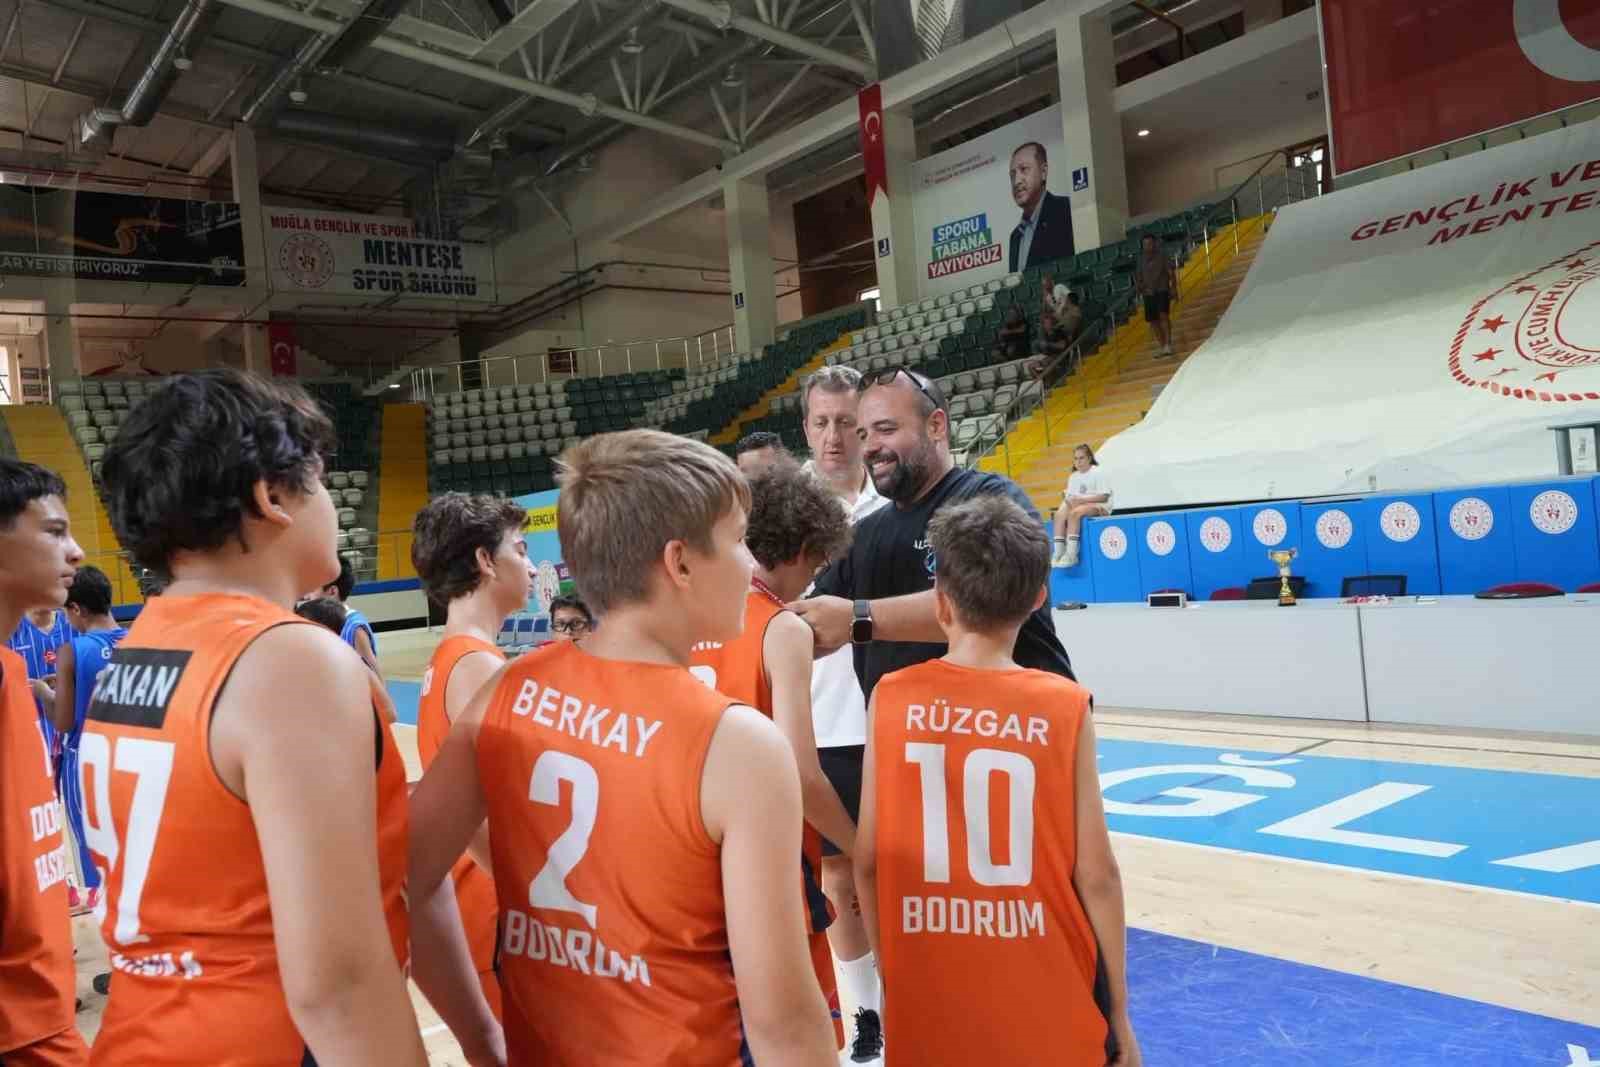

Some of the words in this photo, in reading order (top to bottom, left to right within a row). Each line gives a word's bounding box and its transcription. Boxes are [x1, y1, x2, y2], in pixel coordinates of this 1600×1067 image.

[271, 213, 311, 232] MUĞLA
[364, 223, 379, 235] VE
[380, 224, 410, 237] SPOR
[937, 217, 979, 243] SPORU
[1351, 177, 1538, 241] GENÇLİK
[1427, 190, 1600, 246] MENTE
[363, 239, 463, 269] MENTEŞE
[929, 248, 1000, 278] YAYIYORUZ
[935, 232, 986, 258] TABANA
[352, 268, 403, 293] SPOR
[512, 679, 663, 757] BERKAY
[906, 699, 1049, 746] RÜZGAR
[904, 742, 1036, 887] 10
[528, 750, 599, 929] 2
[902, 896, 1045, 938] BODRUM
[504, 910, 651, 987] BODRUM
